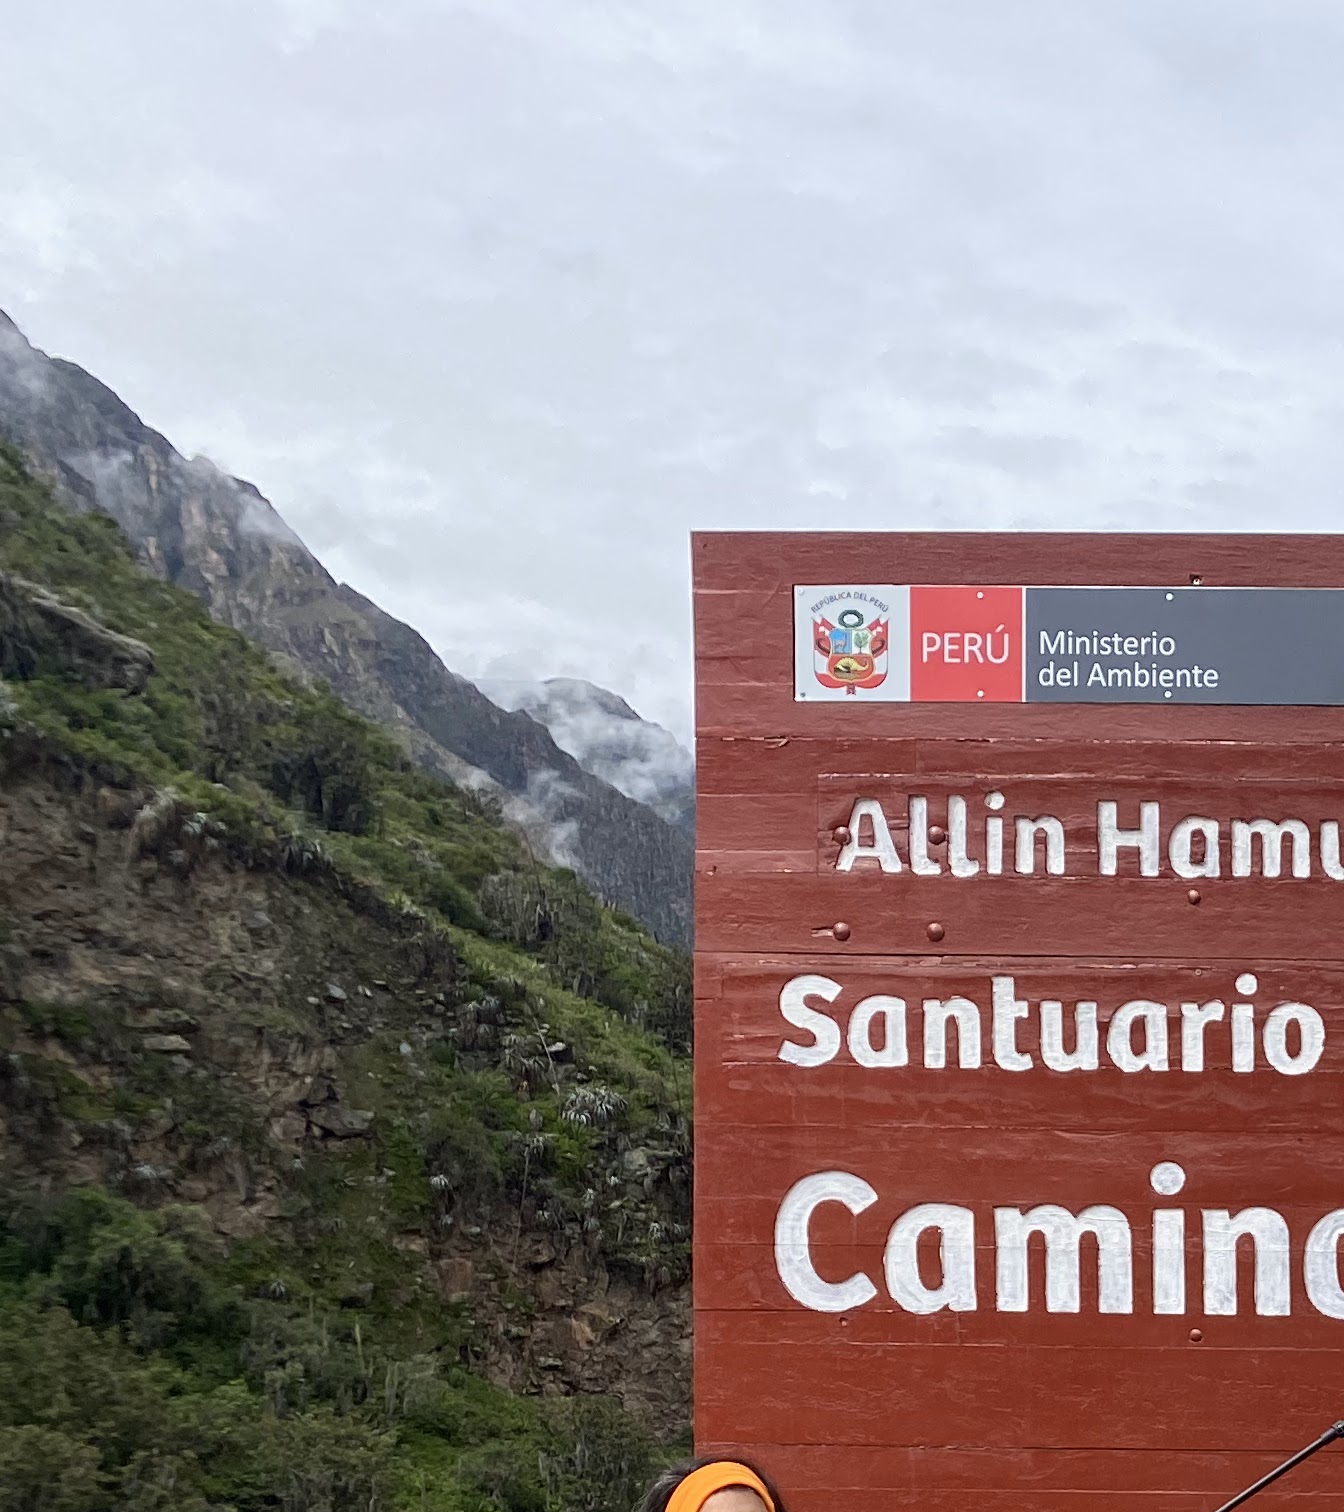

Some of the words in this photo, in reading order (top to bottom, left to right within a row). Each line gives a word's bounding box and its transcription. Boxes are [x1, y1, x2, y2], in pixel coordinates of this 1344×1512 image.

[810, 592, 852, 614] REPÚBLICA
[853, 592, 868, 604] DEL
[868, 596, 890, 614] PERÚ
[922, 623, 1009, 664] PERÚ
[1039, 630, 1176, 656] Ministerio
[1038, 660, 1079, 687] del
[1086, 661, 1219, 688] Ambiente
[836, 792, 1066, 879] Allin
[778, 974, 1326, 1076] Santuario
